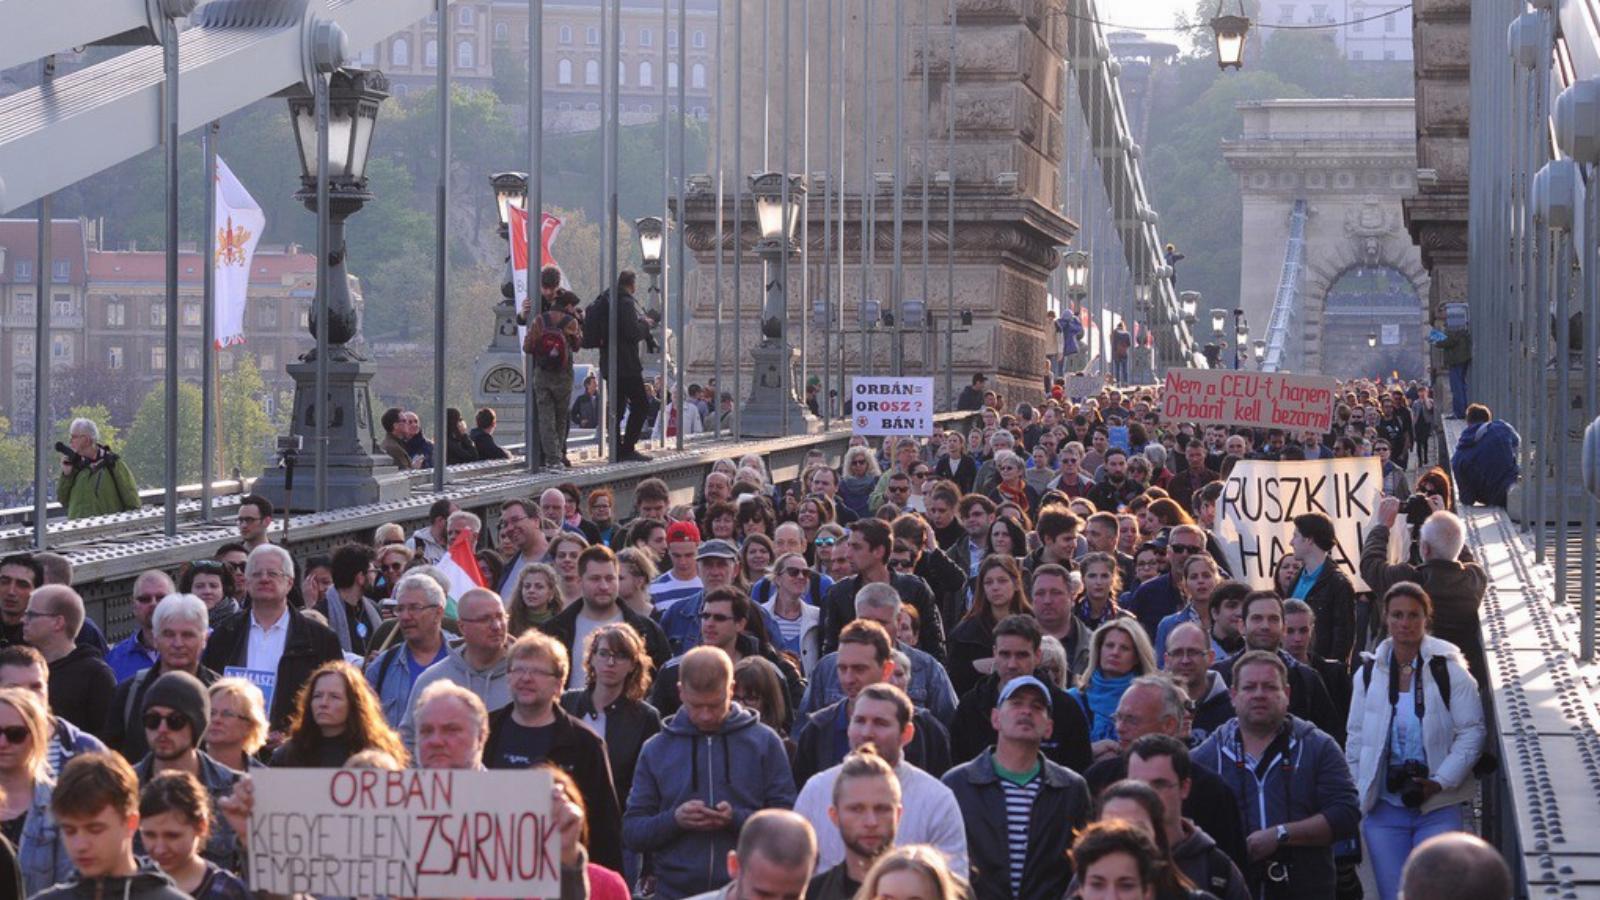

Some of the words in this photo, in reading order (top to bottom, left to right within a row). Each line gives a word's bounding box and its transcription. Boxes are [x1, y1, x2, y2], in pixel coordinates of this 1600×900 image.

[1165, 371, 1202, 394] Nem
[1206, 383, 1216, 395] a
[1279, 378, 1331, 403] hanem
[1165, 394, 1227, 420] Orbánt
[1234, 399, 1262, 422] kell
[1222, 472, 1371, 523] RUSZKIK
[251, 812, 412, 860] KEGYETLEN
[416, 812, 559, 882] ZSARNOK
[255, 854, 418, 897] EMBERTELEN
